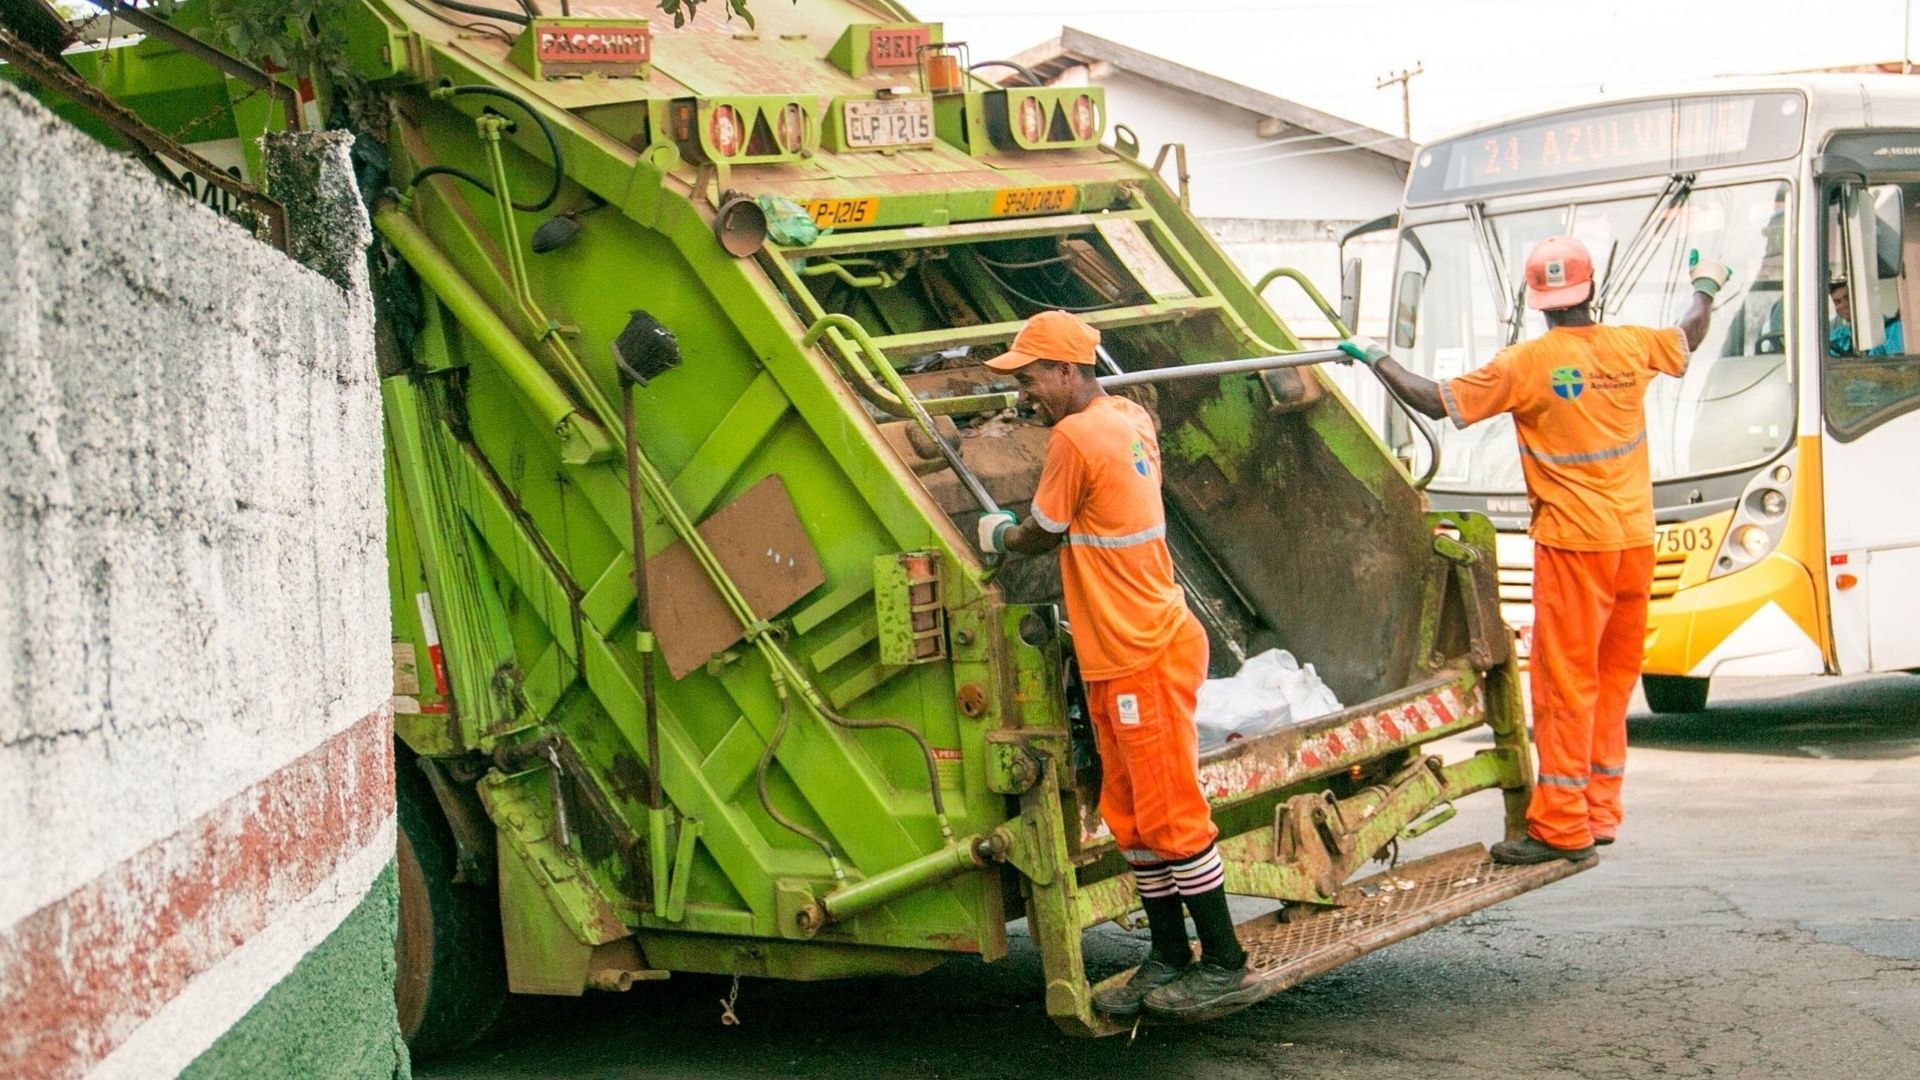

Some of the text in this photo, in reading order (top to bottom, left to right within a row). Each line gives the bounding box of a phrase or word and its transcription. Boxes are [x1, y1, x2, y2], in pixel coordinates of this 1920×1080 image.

[541, 33, 645, 55] PACCHINI
[889, 114, 929, 140] 1215
[1484, 136, 1520, 175] 24
[800, 200, 868, 224] P-1215
[1655, 527, 1713, 553] 7503
